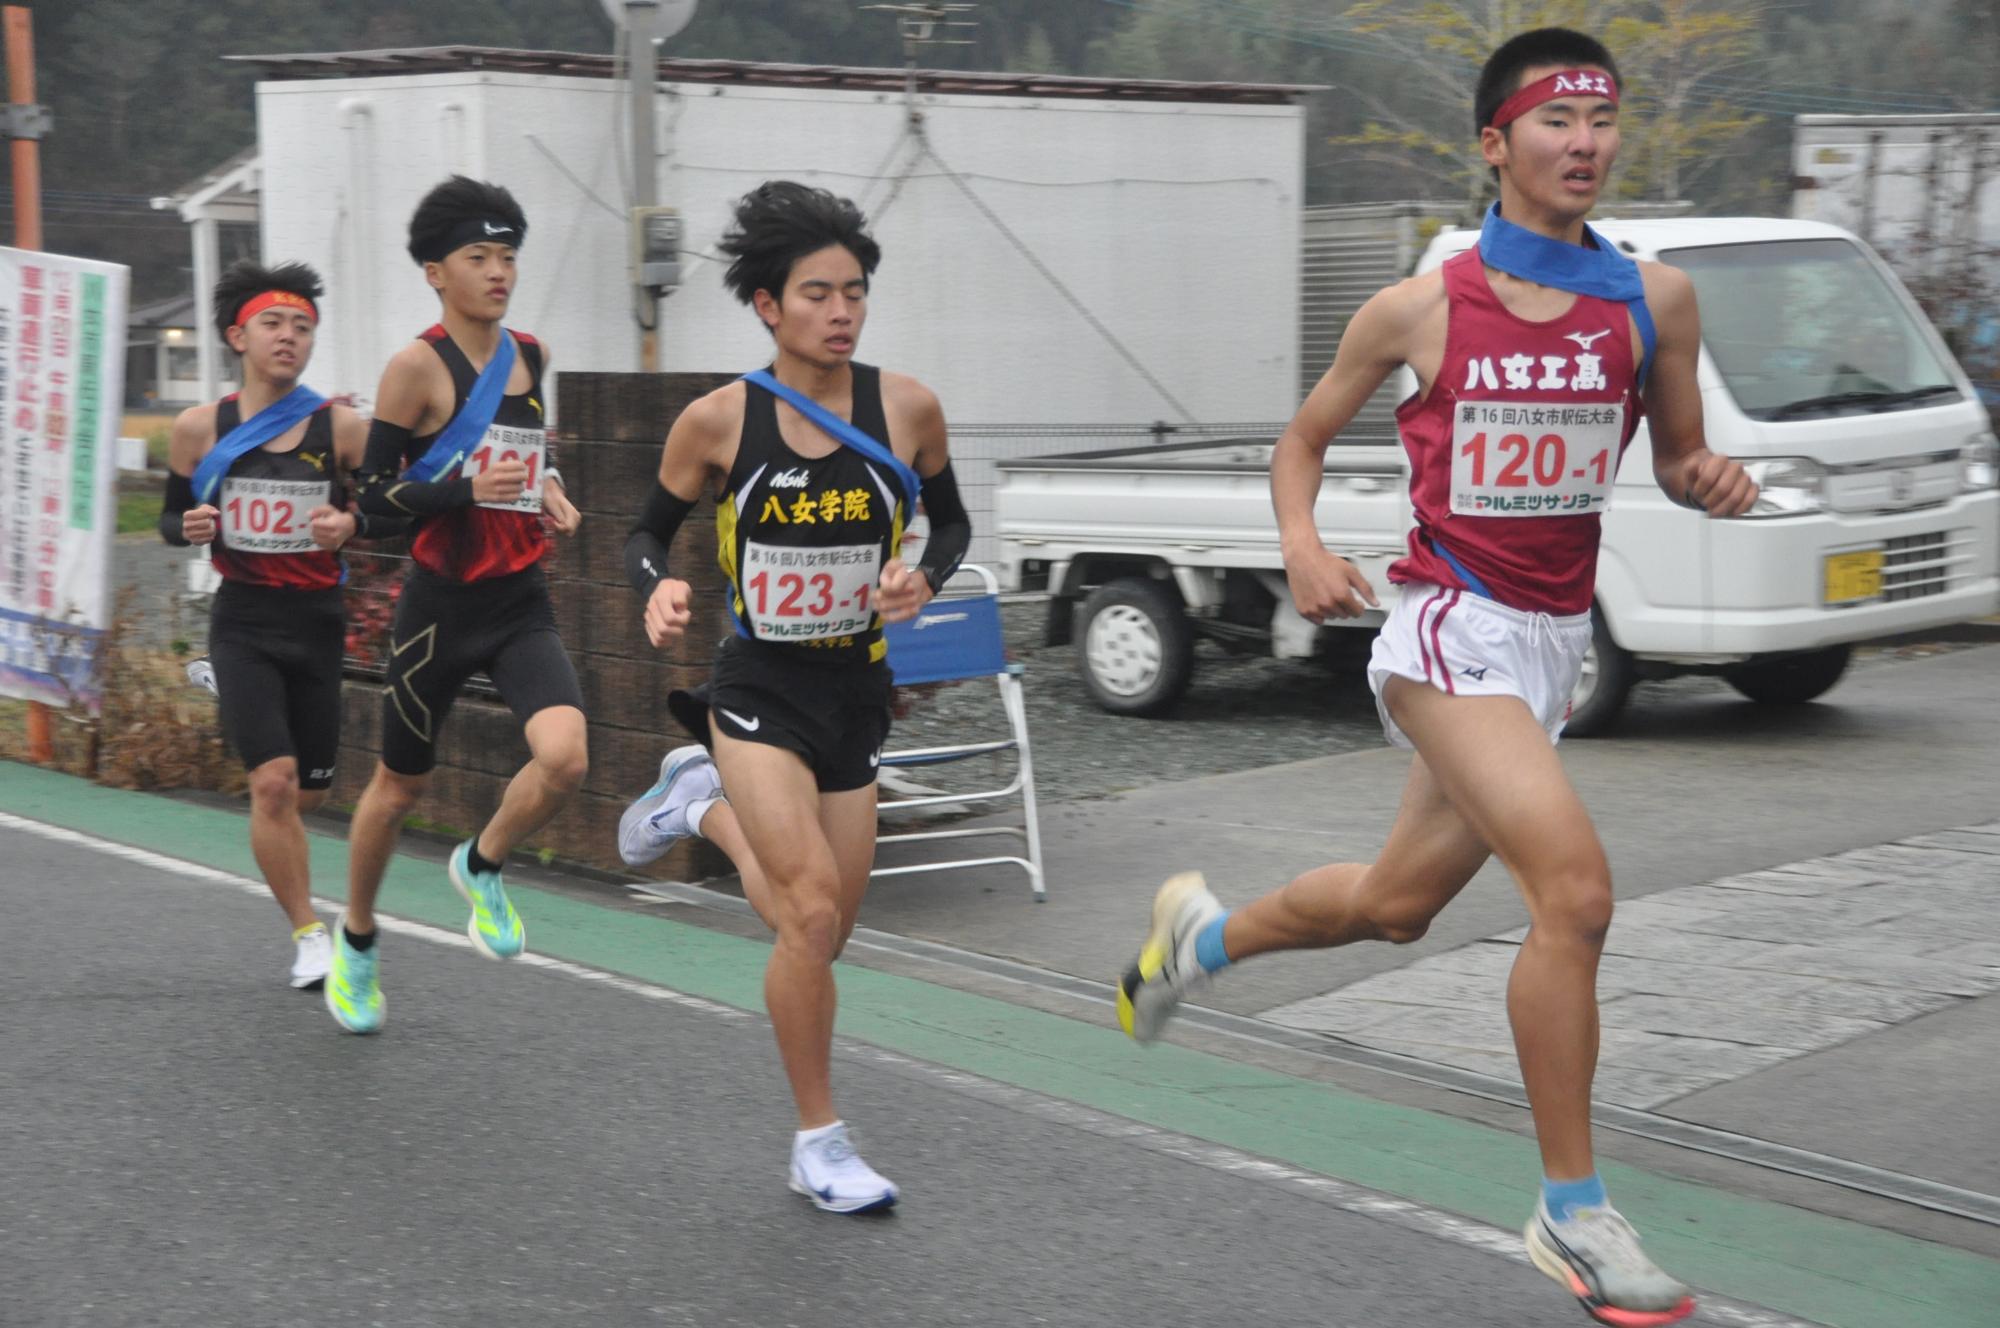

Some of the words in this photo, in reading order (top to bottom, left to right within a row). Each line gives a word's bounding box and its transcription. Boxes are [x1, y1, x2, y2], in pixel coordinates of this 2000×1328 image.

[1554, 73, 1608, 93] 八女工
[1461, 432, 1609, 487] 120-1
[759, 489, 871, 524] 八女学院
[1475, 494, 1604, 511] マルミツサンヨー
[749, 571, 870, 617] 123-1
